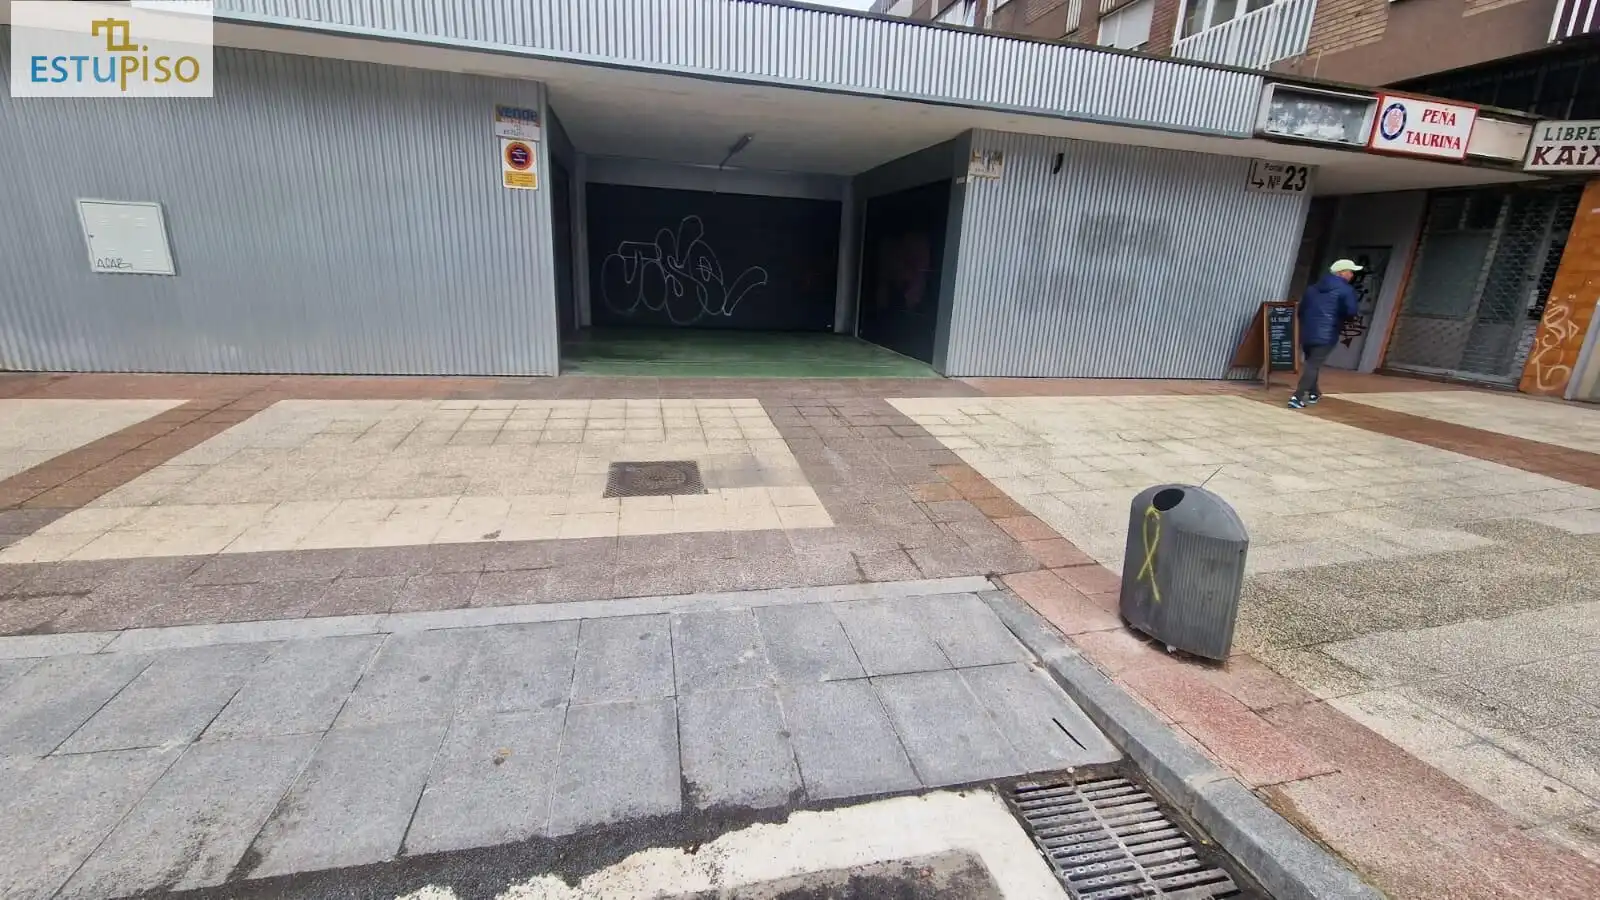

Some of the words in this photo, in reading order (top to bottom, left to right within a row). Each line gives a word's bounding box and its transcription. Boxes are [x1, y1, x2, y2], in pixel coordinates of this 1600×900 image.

[1421, 107, 1457, 126] PEÑA
[1405, 130, 1461, 150] TAURINA
[1281, 165, 1308, 192] 23
